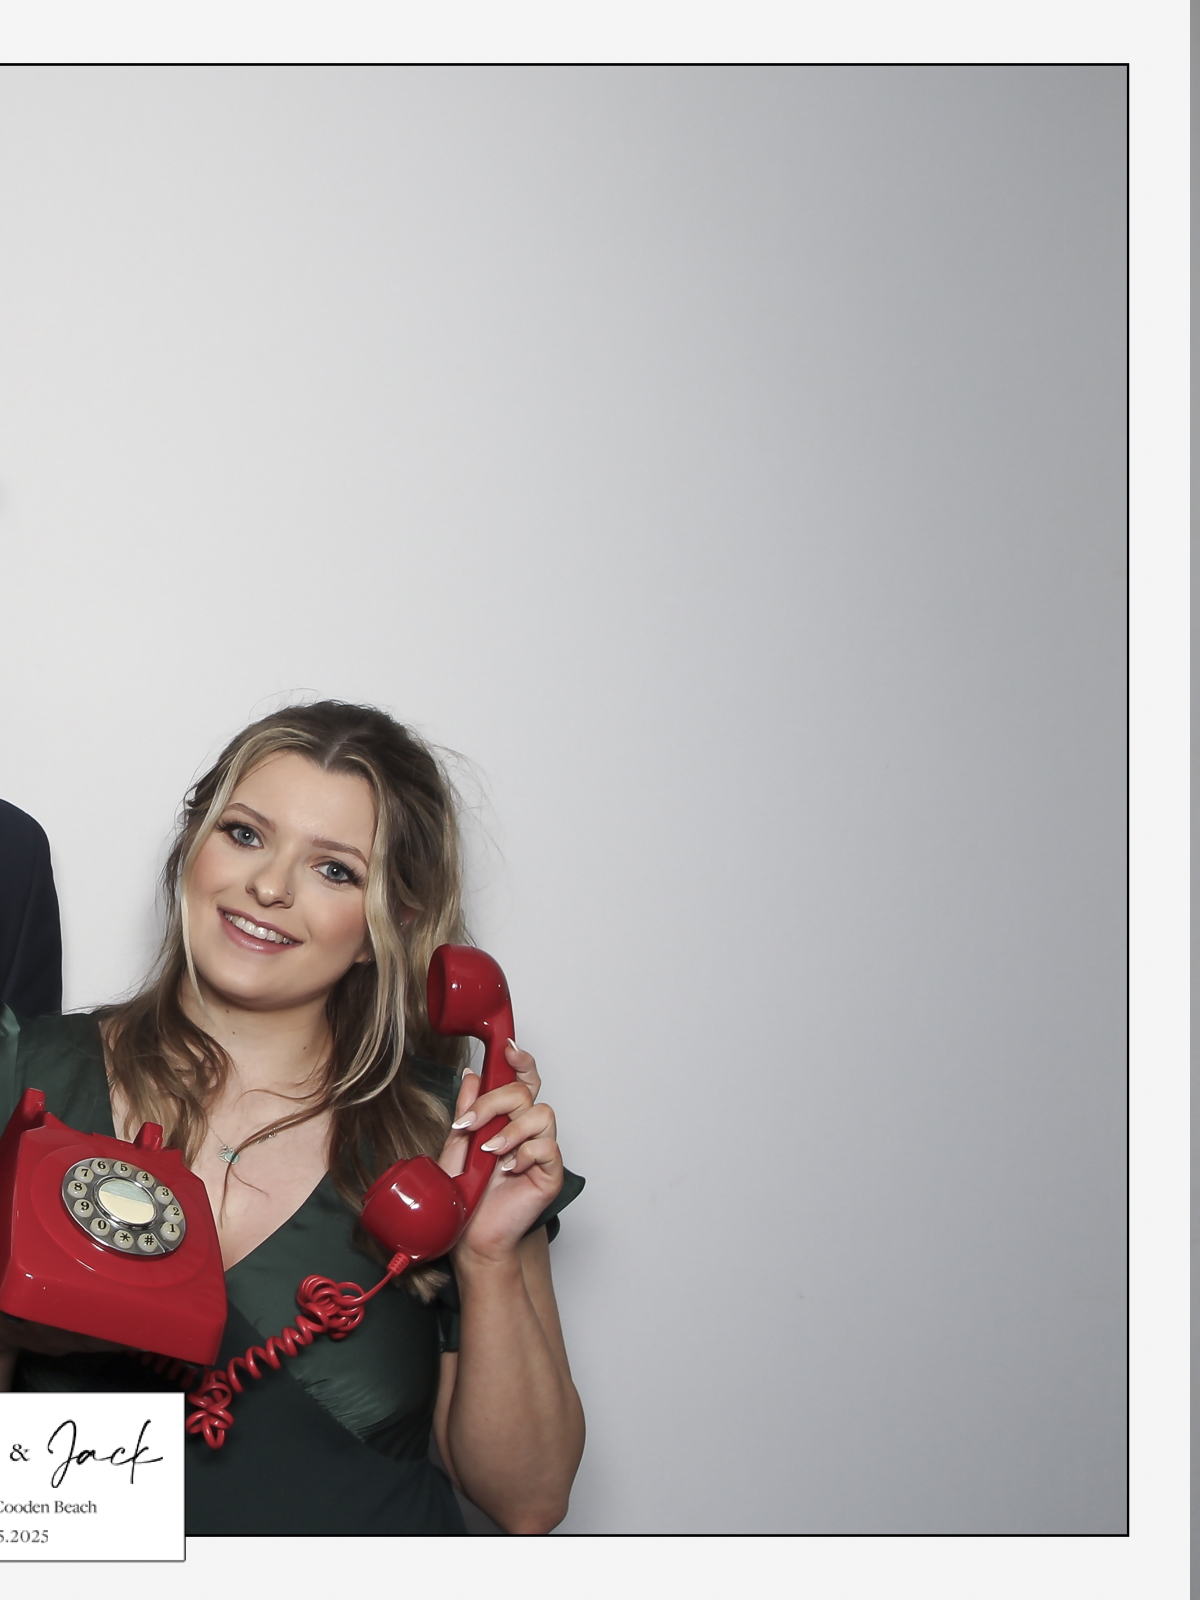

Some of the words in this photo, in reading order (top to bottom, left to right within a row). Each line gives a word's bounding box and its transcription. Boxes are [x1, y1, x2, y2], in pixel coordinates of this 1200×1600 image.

[97, 1161, 106, 1170] 6
[120, 1163, 128, 1172] 5
[81, 1168, 89, 1177] 7
[141, 1172, 149, 1181] 4
[73, 1182, 83, 1191] 8
[162, 1187, 170, 1197] 3
[80, 1201, 90, 1211] 9
[172, 1207, 180, 1216] 2
[97, 1219, 107, 1230] 0
[169, 1223, 176, 1233] 1
[144, 1235, 154, 1246] #
